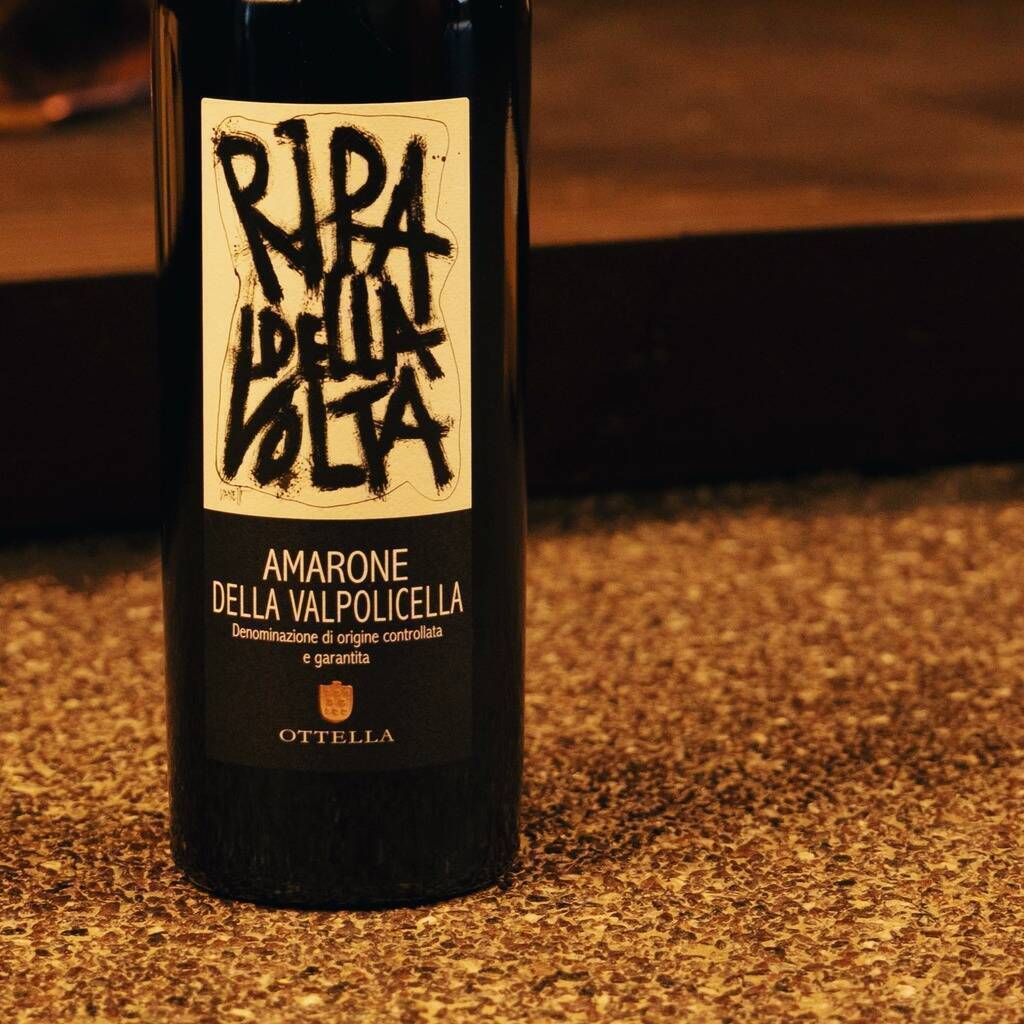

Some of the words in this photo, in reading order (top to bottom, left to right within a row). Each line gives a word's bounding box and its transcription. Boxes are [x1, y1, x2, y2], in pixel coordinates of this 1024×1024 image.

[216, 119, 454, 324] RIPA
[248, 273, 447, 381] DELLA
[222, 339, 454, 495] VOLTA
[262, 548, 409, 583] AMARONE
[212, 580, 281, 621] DELLA
[289, 581, 464, 623] VALPOLICELLA
[232, 623, 318, 644] Denominazione
[322, 630, 334, 644] di
[337, 630, 379, 648] origine
[383, 624, 443, 643] controllata
[302, 653, 311, 664] e
[314, 650, 370, 668] garantita
[279, 728, 395, 744] OTTELLA
